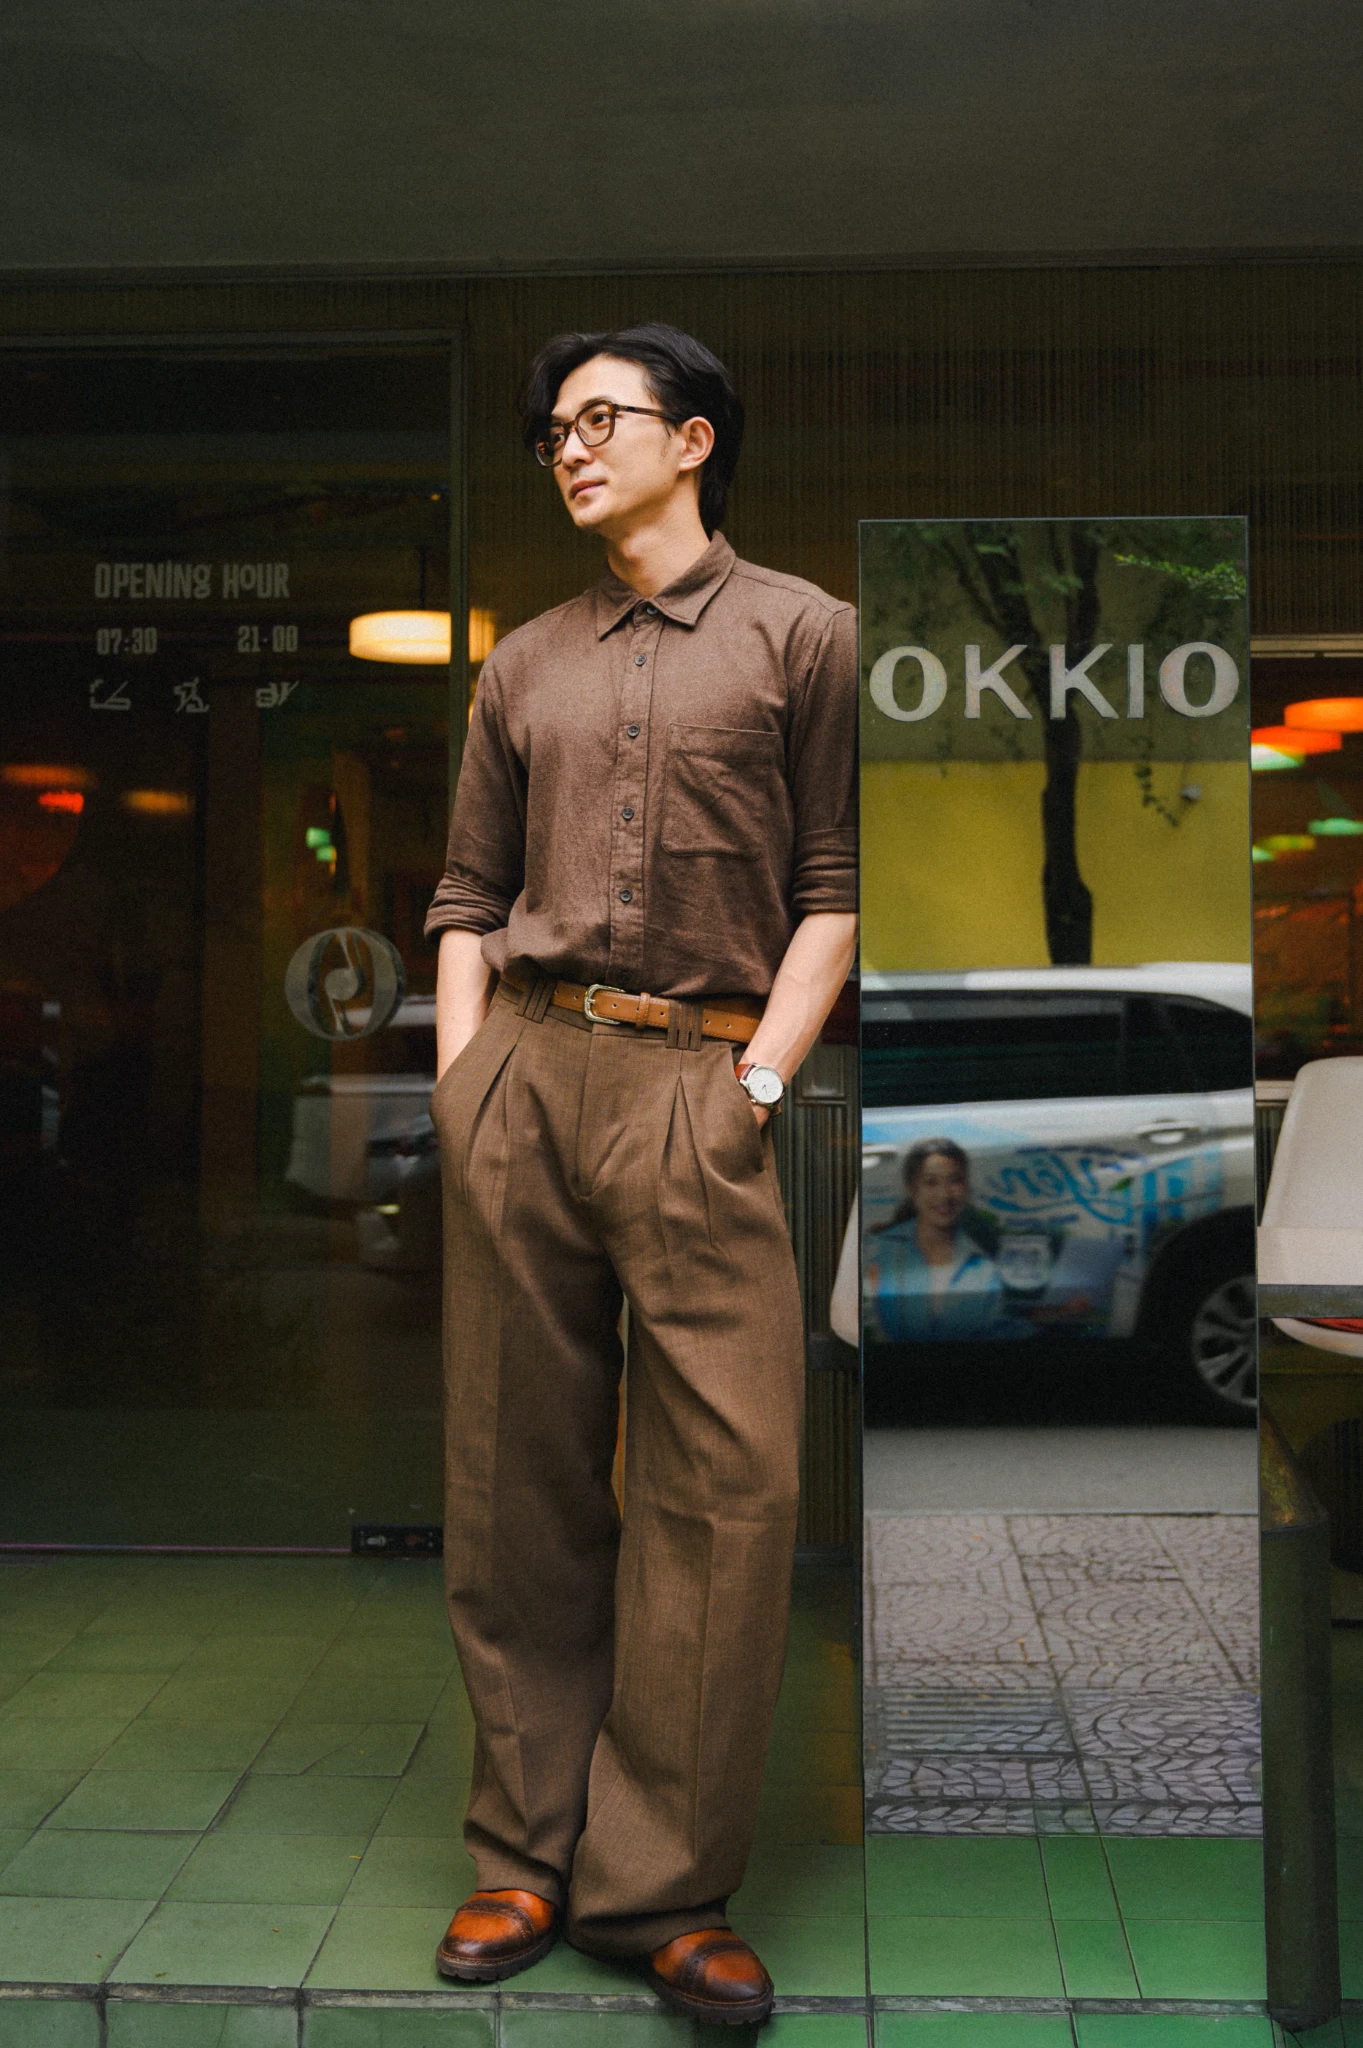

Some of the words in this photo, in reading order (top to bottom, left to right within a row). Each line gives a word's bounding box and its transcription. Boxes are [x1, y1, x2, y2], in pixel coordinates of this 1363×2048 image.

[95, 559, 211, 598] OPENING
[223, 563, 289, 598] HOUR
[96, 627, 157, 655] 07:30
[869, 641, 1239, 722] OKKIO
